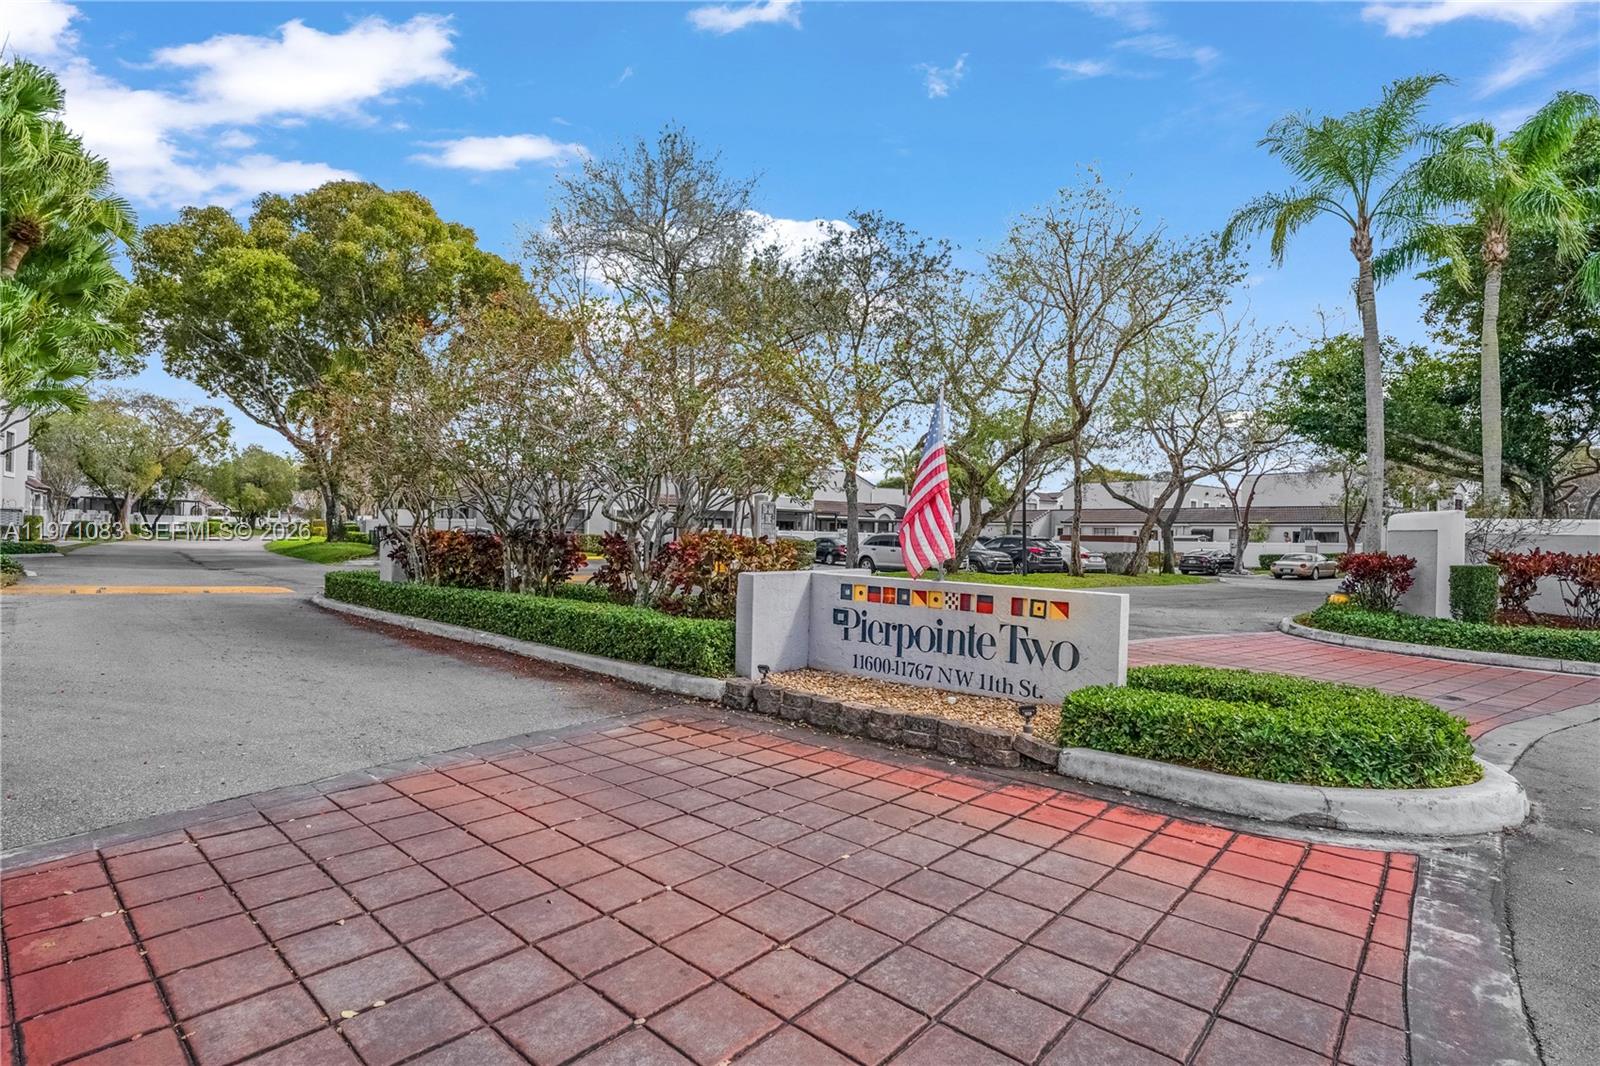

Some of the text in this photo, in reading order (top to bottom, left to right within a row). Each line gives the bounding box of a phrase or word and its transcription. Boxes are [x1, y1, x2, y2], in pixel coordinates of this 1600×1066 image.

[840, 608, 1080, 672] Pierpointe Two
[853, 654, 1044, 699] 11600-11767 NW 11th St.
